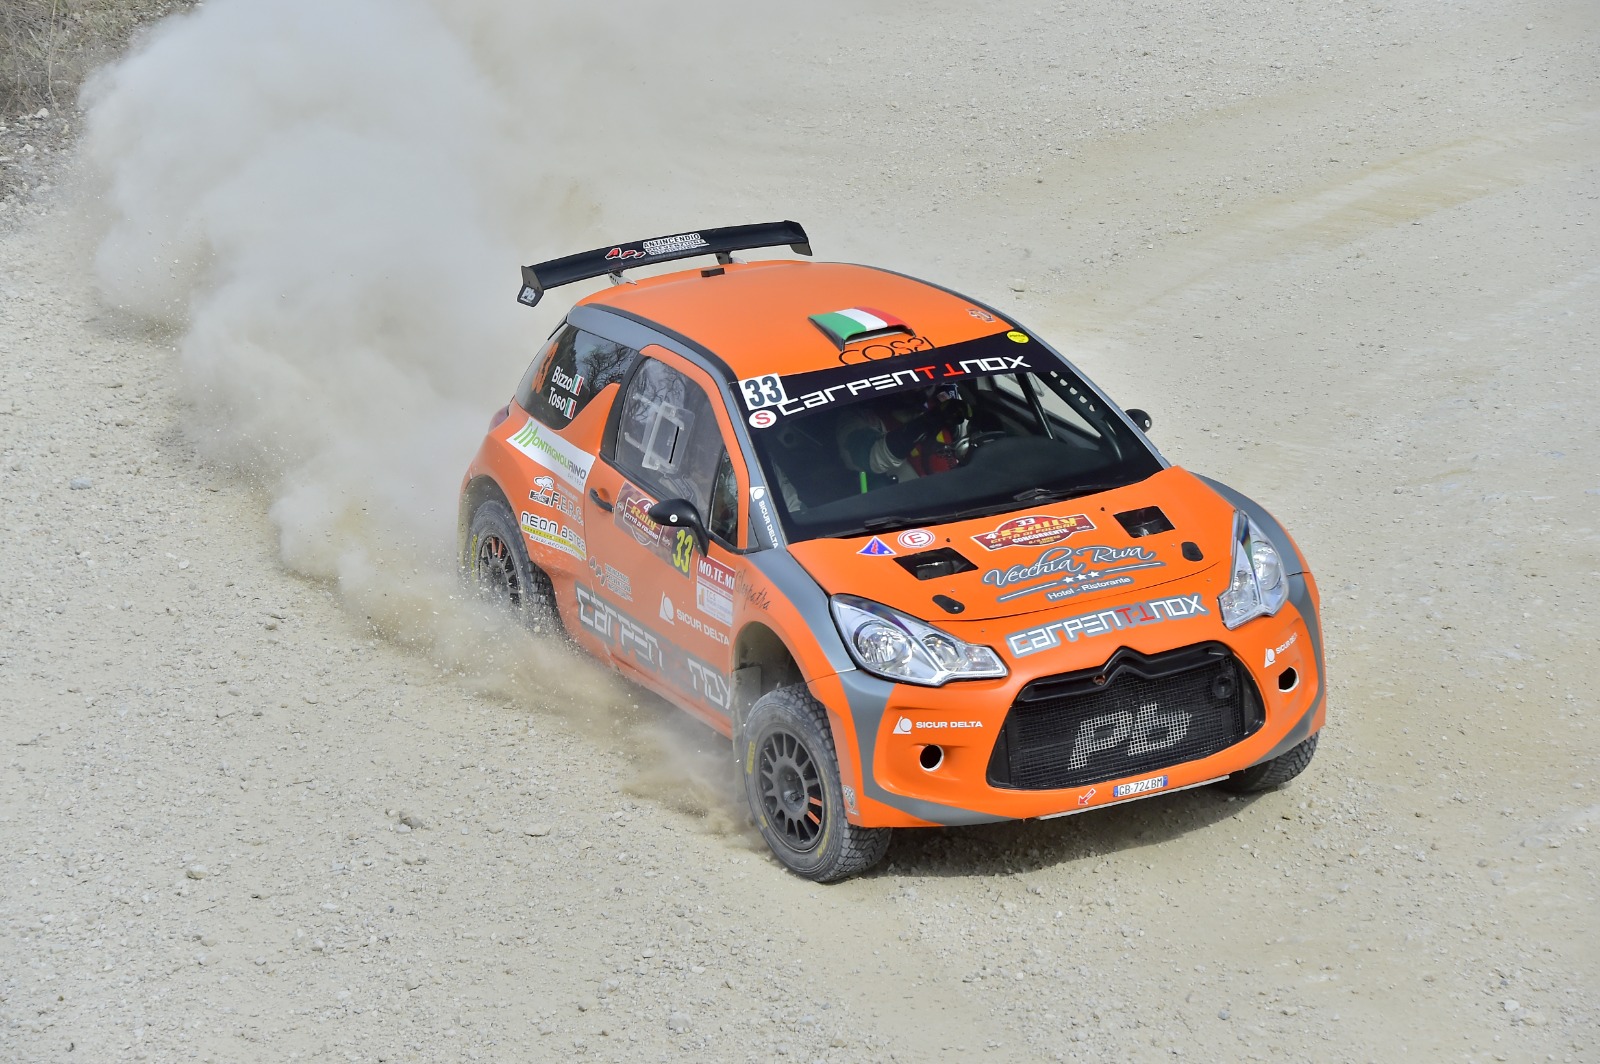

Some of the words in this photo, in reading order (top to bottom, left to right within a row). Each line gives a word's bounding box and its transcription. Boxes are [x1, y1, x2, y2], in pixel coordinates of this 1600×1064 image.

[552, 366, 573, 391] Bizzo
[744, 375, 782, 407] 33
[755, 412, 771, 425] S
[1016, 518, 1035, 527] 33
[766, 523, 779, 549] DELTA
[908, 533, 925, 544] E
[672, 529, 694, 573] 33
[983, 547, 1084, 586] Vecchia
[1075, 546, 1154, 563] Riva
[1047, 588, 1075, 600] Hotel
[677, 609, 702, 633] SICUR
[703, 624, 730, 646] DELTA
[916, 721, 948, 729] SICUR
